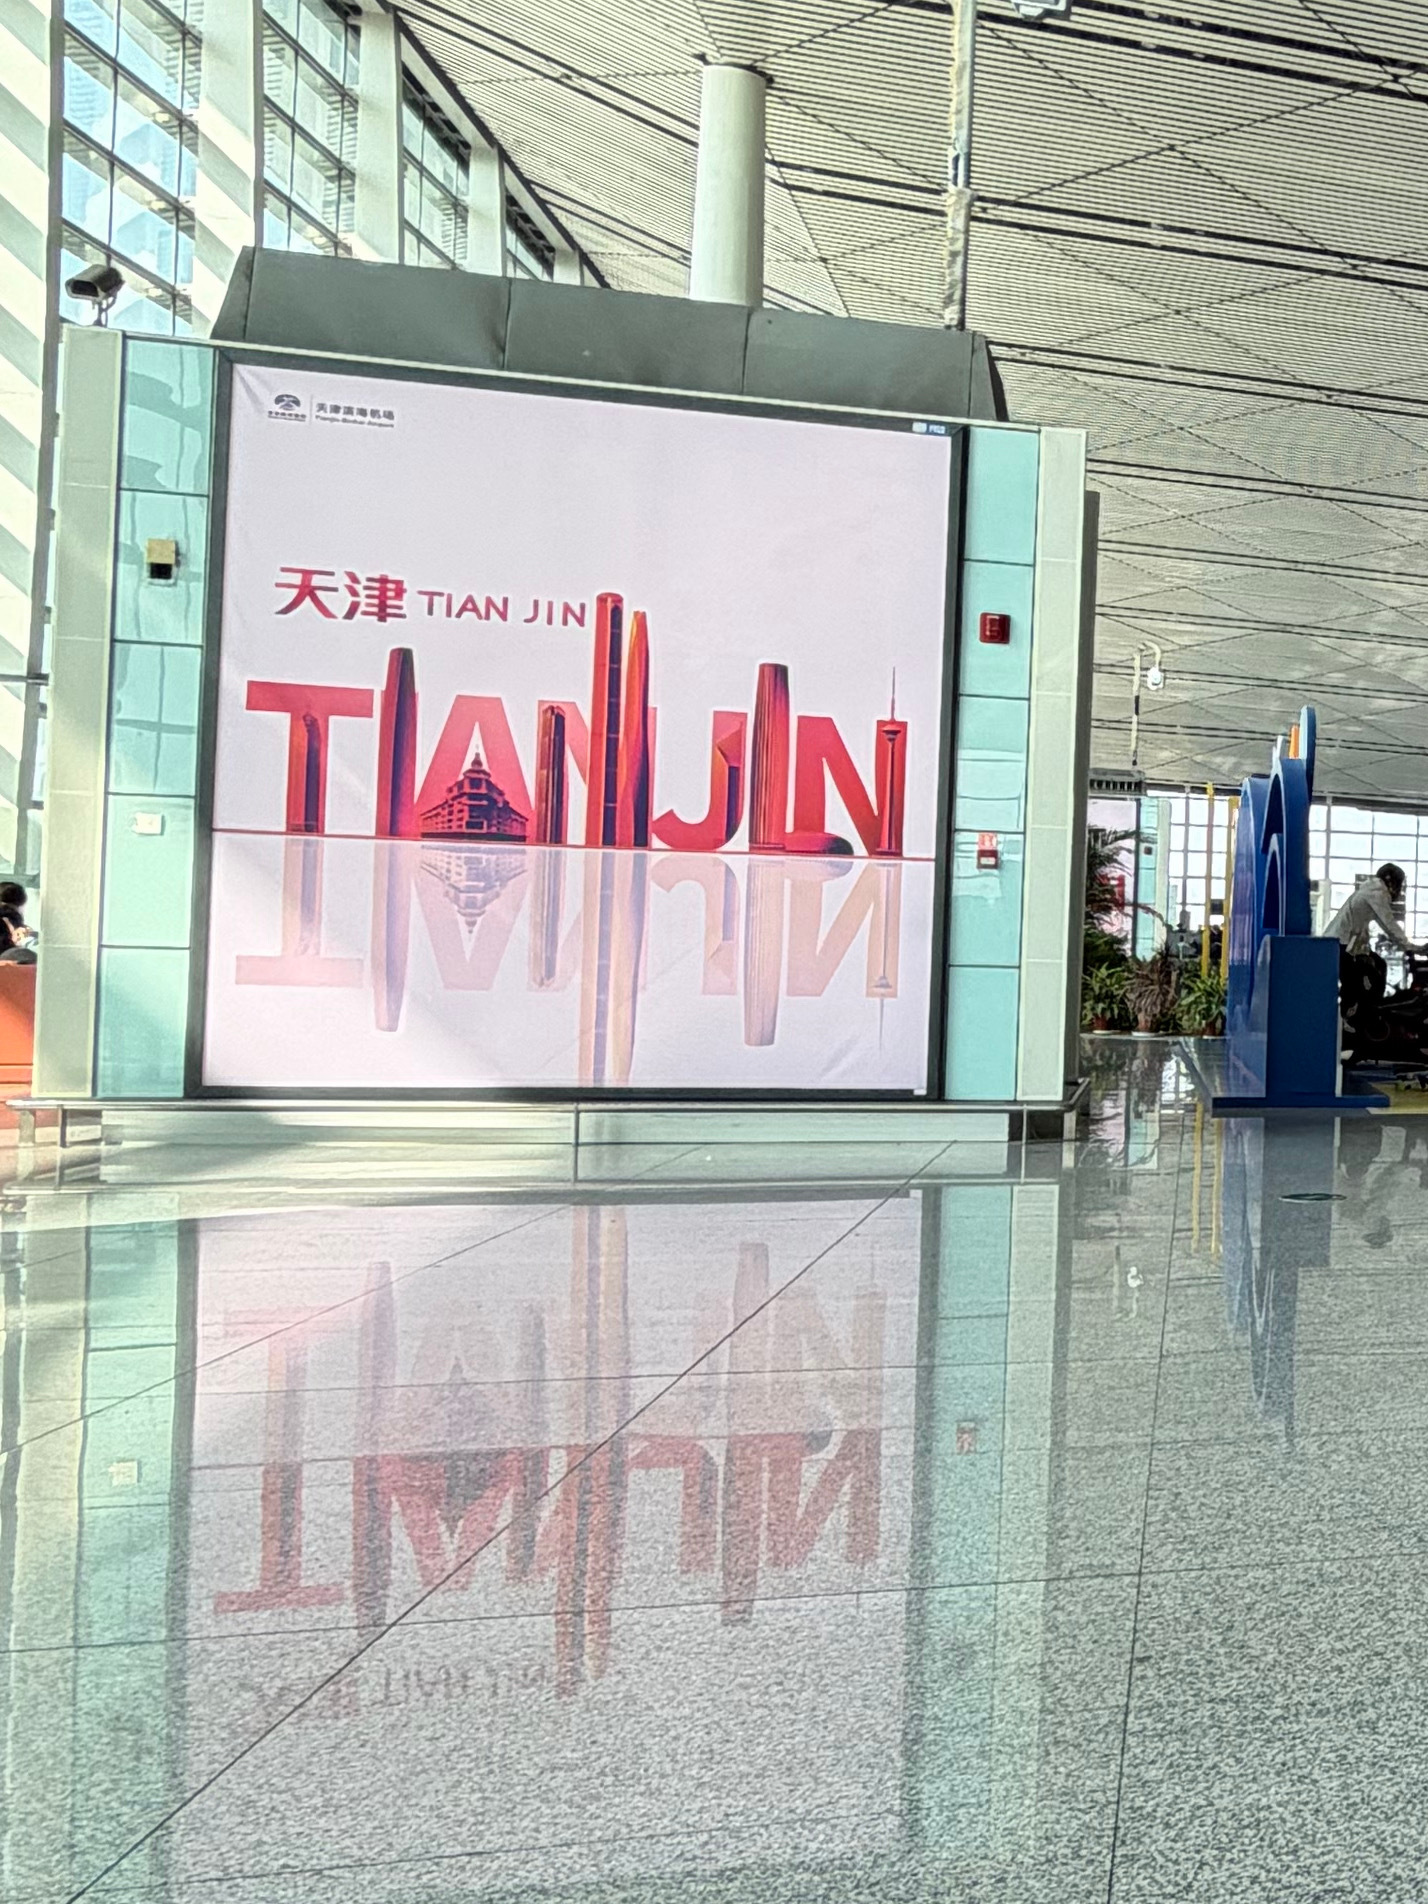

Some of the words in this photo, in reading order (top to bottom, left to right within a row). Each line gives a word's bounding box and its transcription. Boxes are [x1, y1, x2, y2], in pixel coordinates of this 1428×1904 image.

[274, 566, 407, 623] 天津
[417, 589, 509, 622] TIAN
[523, 598, 586, 628] JIN
[246, 648, 908, 856] TIANJIN
